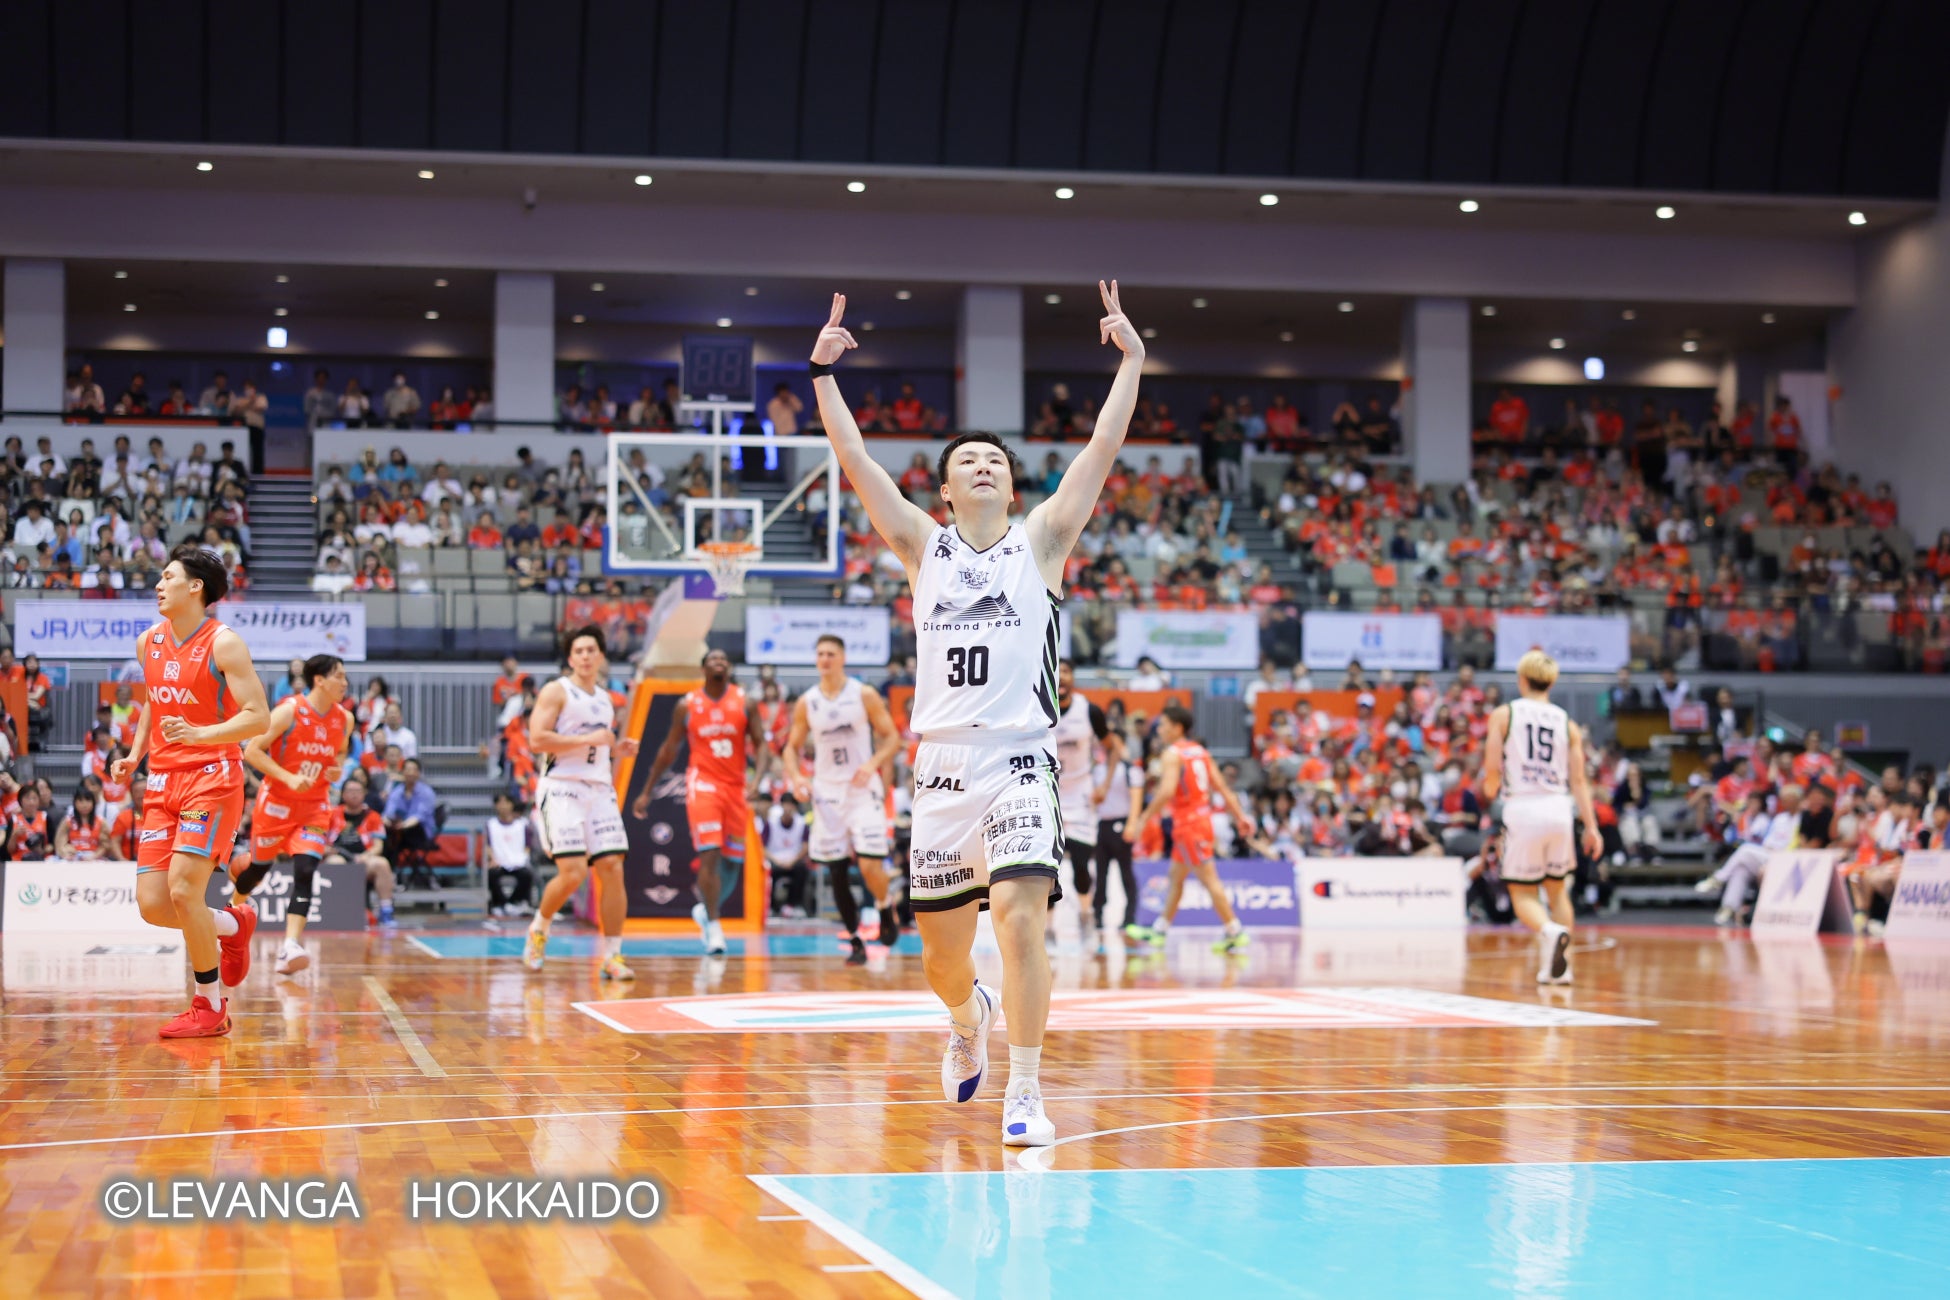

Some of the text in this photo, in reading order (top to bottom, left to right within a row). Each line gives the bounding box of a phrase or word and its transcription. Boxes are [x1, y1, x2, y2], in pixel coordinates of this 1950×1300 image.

[923, 622, 979, 632] Diamond
[947, 645, 989, 687] 30
[148, 686, 200, 704] NOVA
[297, 741, 335, 757] NOVA
[1526, 724, 1554, 763] 15
[586, 745, 597, 765] 2
[1009, 754, 1036, 775] 30
[926, 776, 965, 792] JAL
[995, 797, 1041, 818] 北洋銀行
[926, 850, 962, 863] Ohfuji
